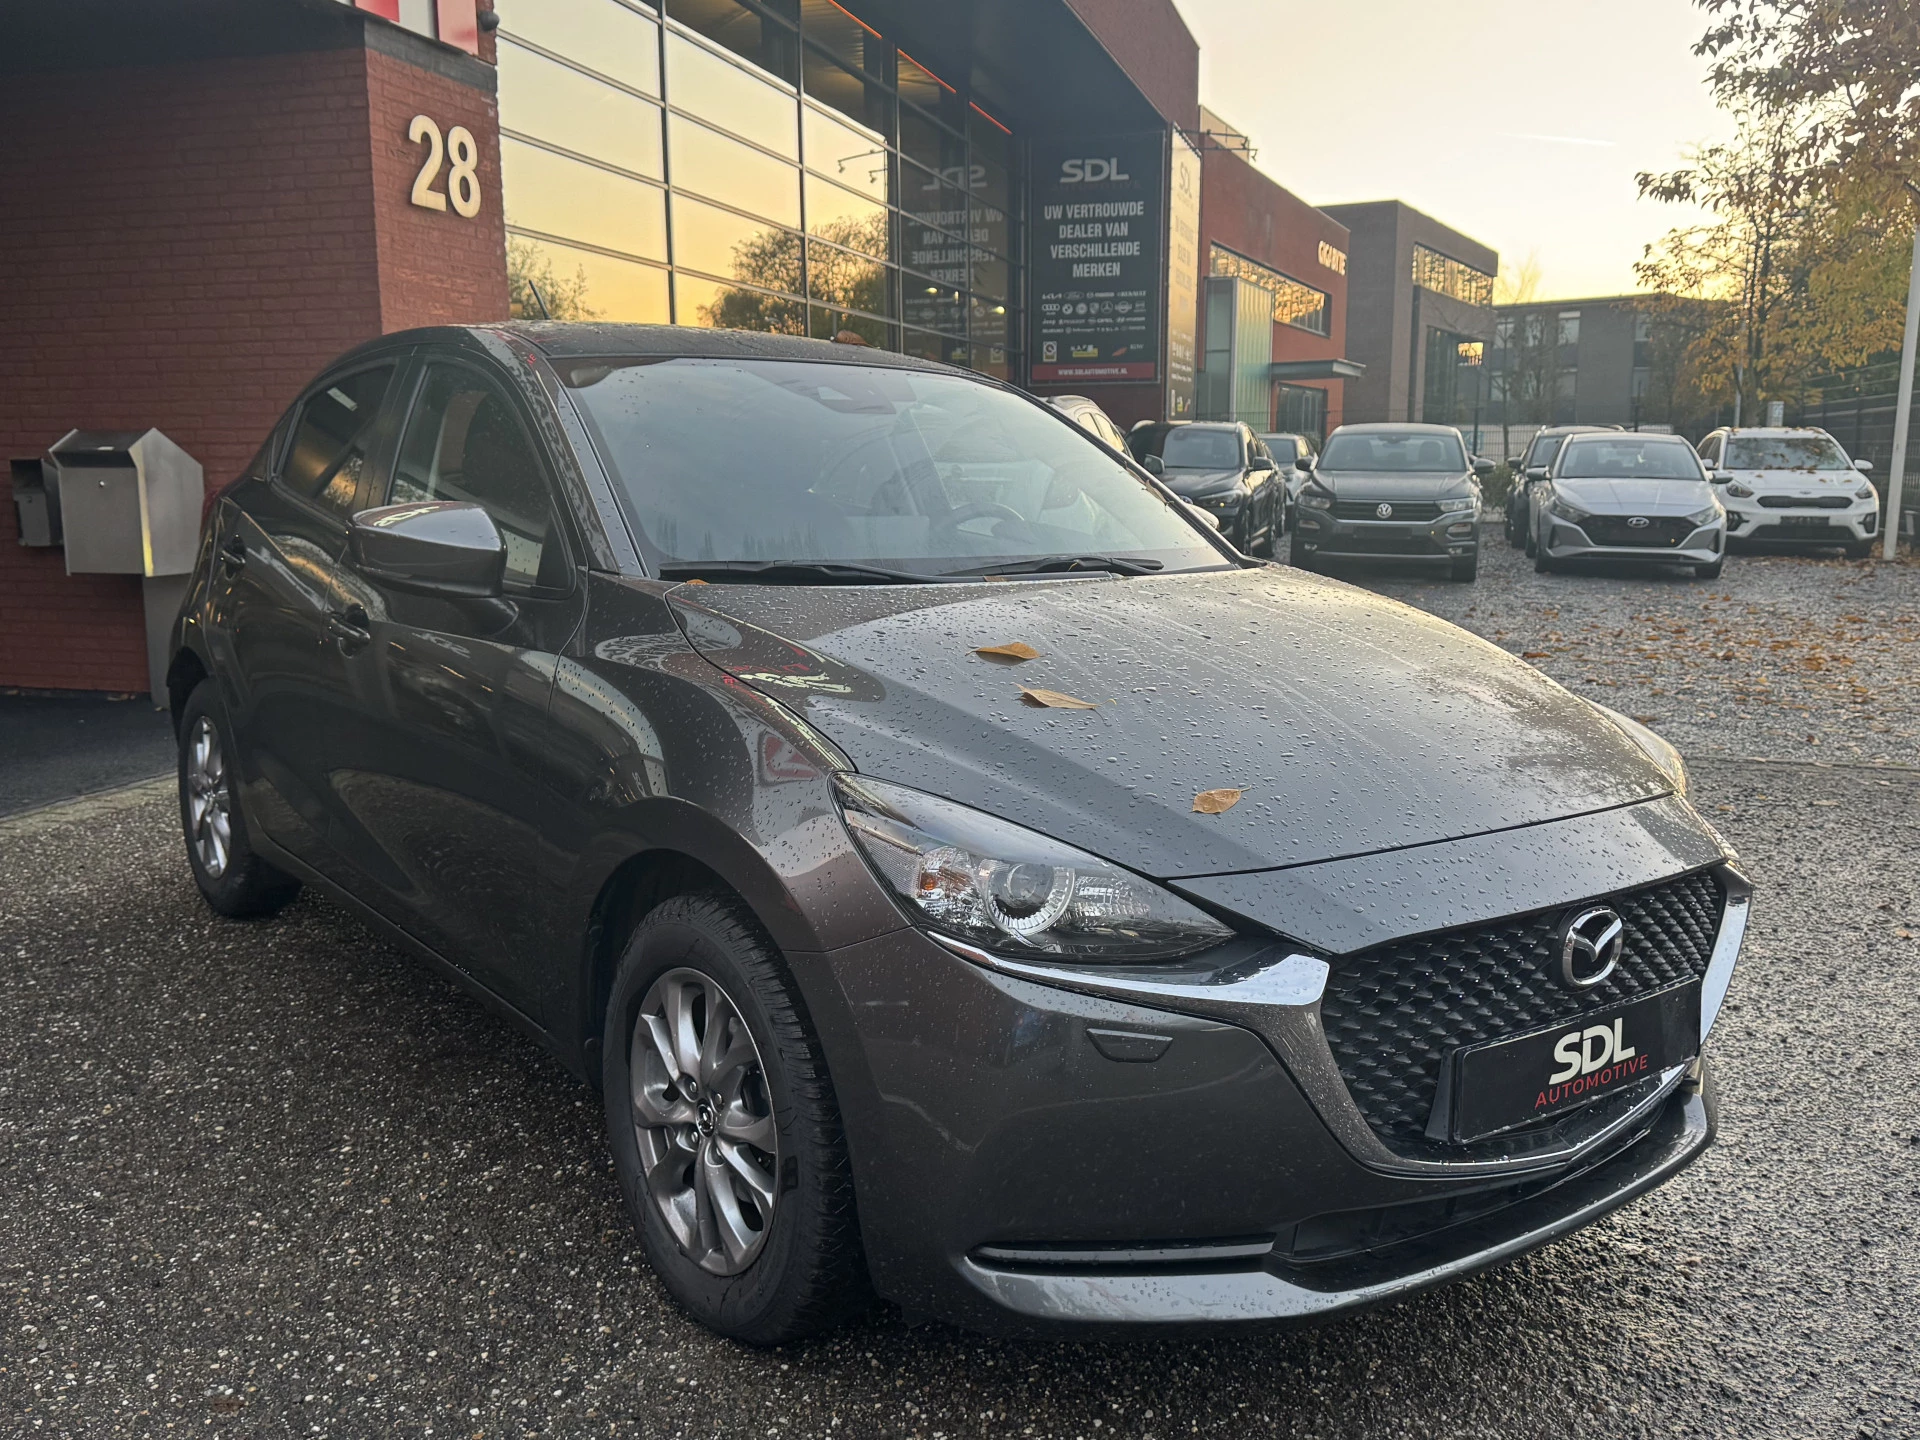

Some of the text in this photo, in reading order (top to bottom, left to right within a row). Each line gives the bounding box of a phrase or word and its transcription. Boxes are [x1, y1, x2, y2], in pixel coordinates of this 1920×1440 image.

[408, 114, 482, 219] 28
[1059, 157, 1130, 183] SDL
[1044, 201, 1144, 220] UW VERTROUWDE
[1059, 222, 1129, 239] DEALER VAN
[1050, 241, 1141, 259] VERSCHILLENDE
[1072, 262, 1121, 278] MERKEN
[1548, 1017, 1636, 1085] SDL
[1534, 1053, 1649, 1110] AUTOMOTIVE
